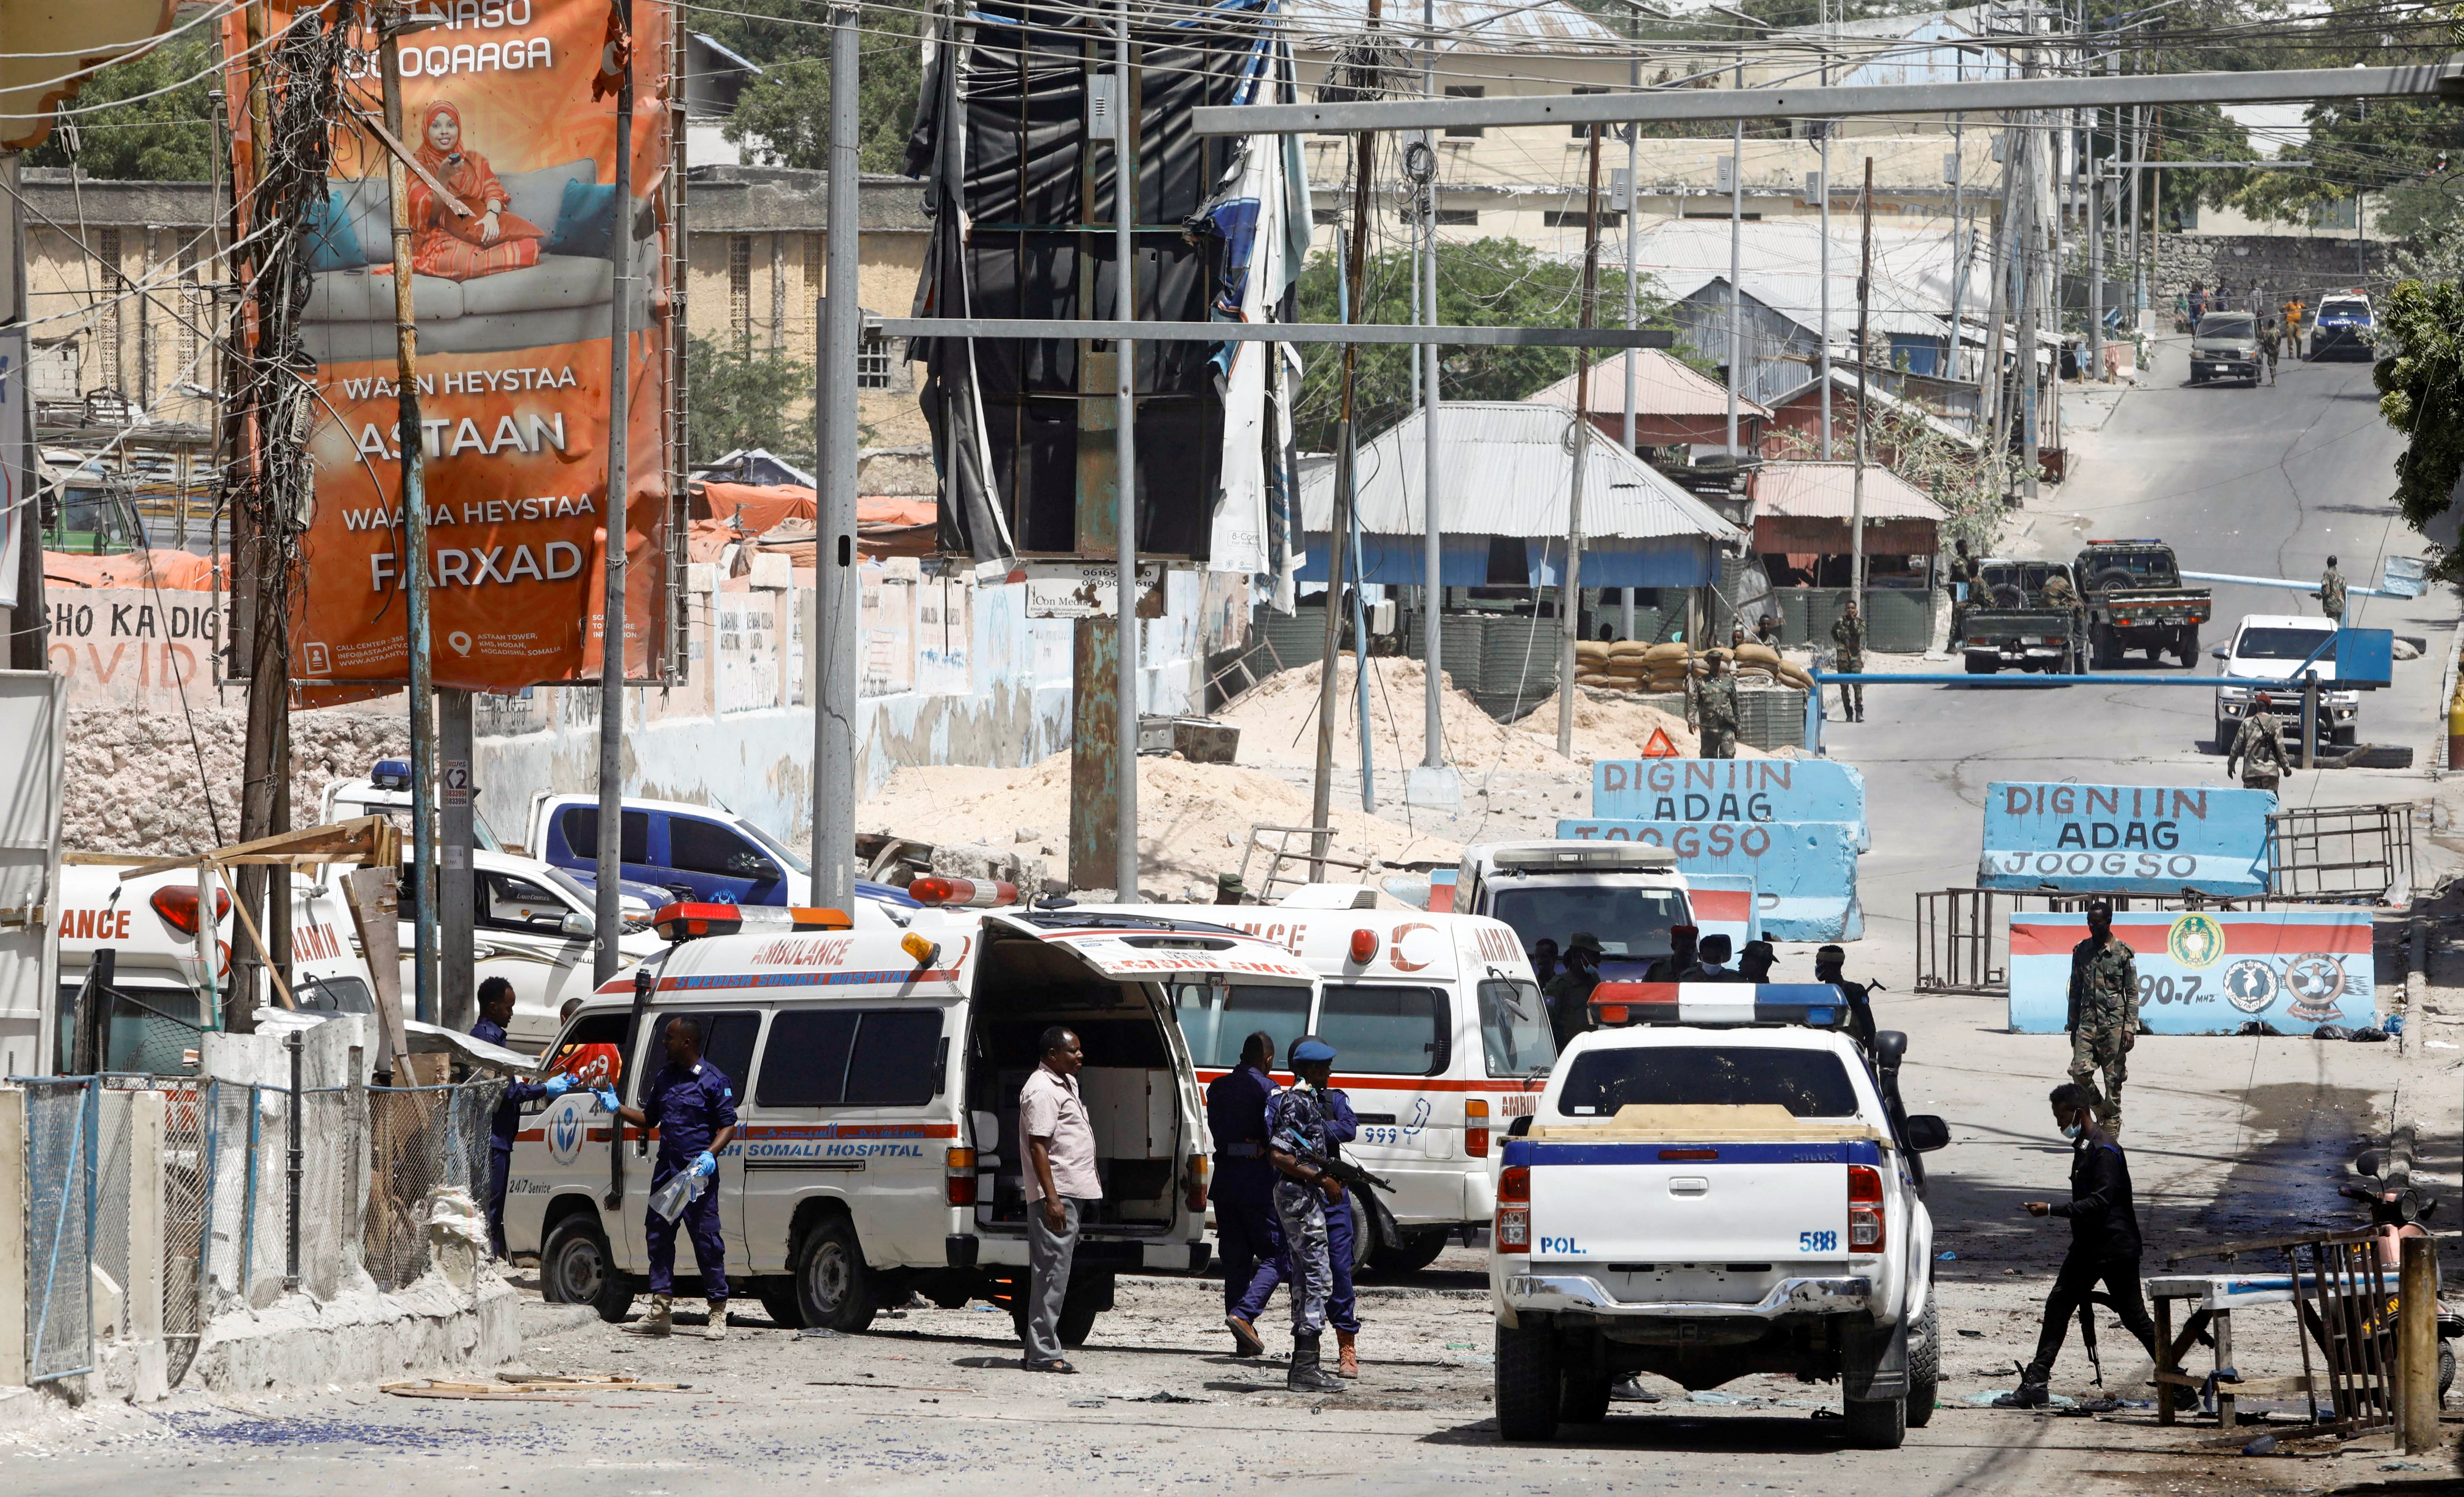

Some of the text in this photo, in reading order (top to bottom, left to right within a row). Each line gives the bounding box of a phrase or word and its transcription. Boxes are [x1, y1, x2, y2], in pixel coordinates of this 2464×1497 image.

[345, 37, 552, 79] DOQAAGA
[445, 366, 577, 394] HEYSTAA
[464, 493, 596, 524] HEYSTAA
[1033, 595, 1055, 606] iCon
[111, 603, 155, 638] KA
[356, 639, 386, 649] CENTER
[1604, 761, 1792, 792] DIGNIIN
[1655, 793, 1772, 822] ADAG
[2006, 785, 2207, 820] DIGNIIN
[2057, 821, 2180, 850] ADAG
[2004, 852, 2197, 879] JOOGSO
[750, 938, 855, 966] AMBULANCE
[1473, 928, 1521, 962] AAMIN
[573, 956, 595, 965] HILU
[674, 970, 910, 988] SWEDISH SOMALI HOSPITAL
[2196, 993, 2217, 1004] MHZ
[1502, 1096, 1542, 1117] AMBUL
[1365, 1127, 1396, 1143] 999
[748, 1144, 821, 1156] SOMALI
[826, 1144, 923, 1157] HOSPITAL
[509, 1177, 551, 1195] 24/7 Service
[1540, 1237, 1587, 1255] POL.
[1799, 1230, 1837, 1252] 588
